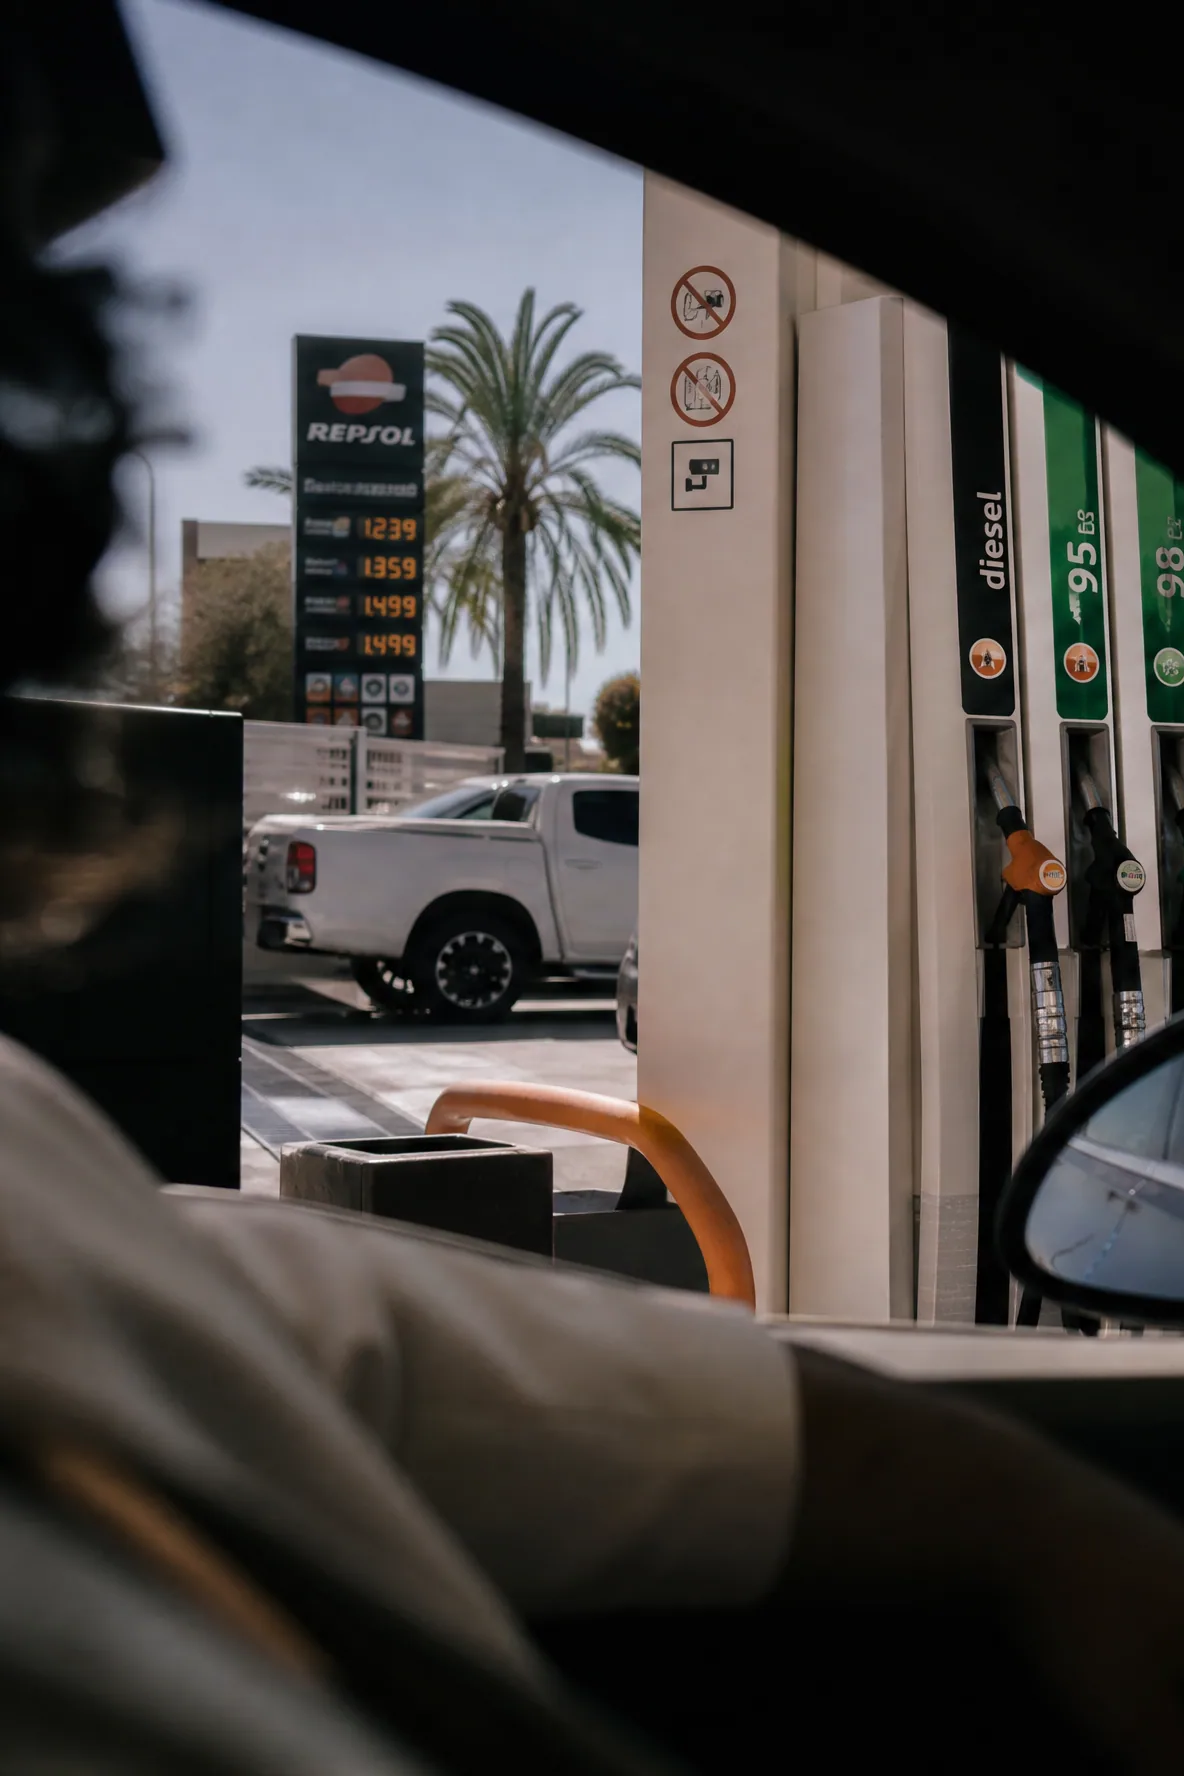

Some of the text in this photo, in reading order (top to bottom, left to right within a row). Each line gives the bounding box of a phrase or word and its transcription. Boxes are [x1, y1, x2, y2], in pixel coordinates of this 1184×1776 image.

[306, 421, 416, 446] REPSOL
[976, 491, 1006, 590] diesel
[1066, 541, 1098, 594] 95
